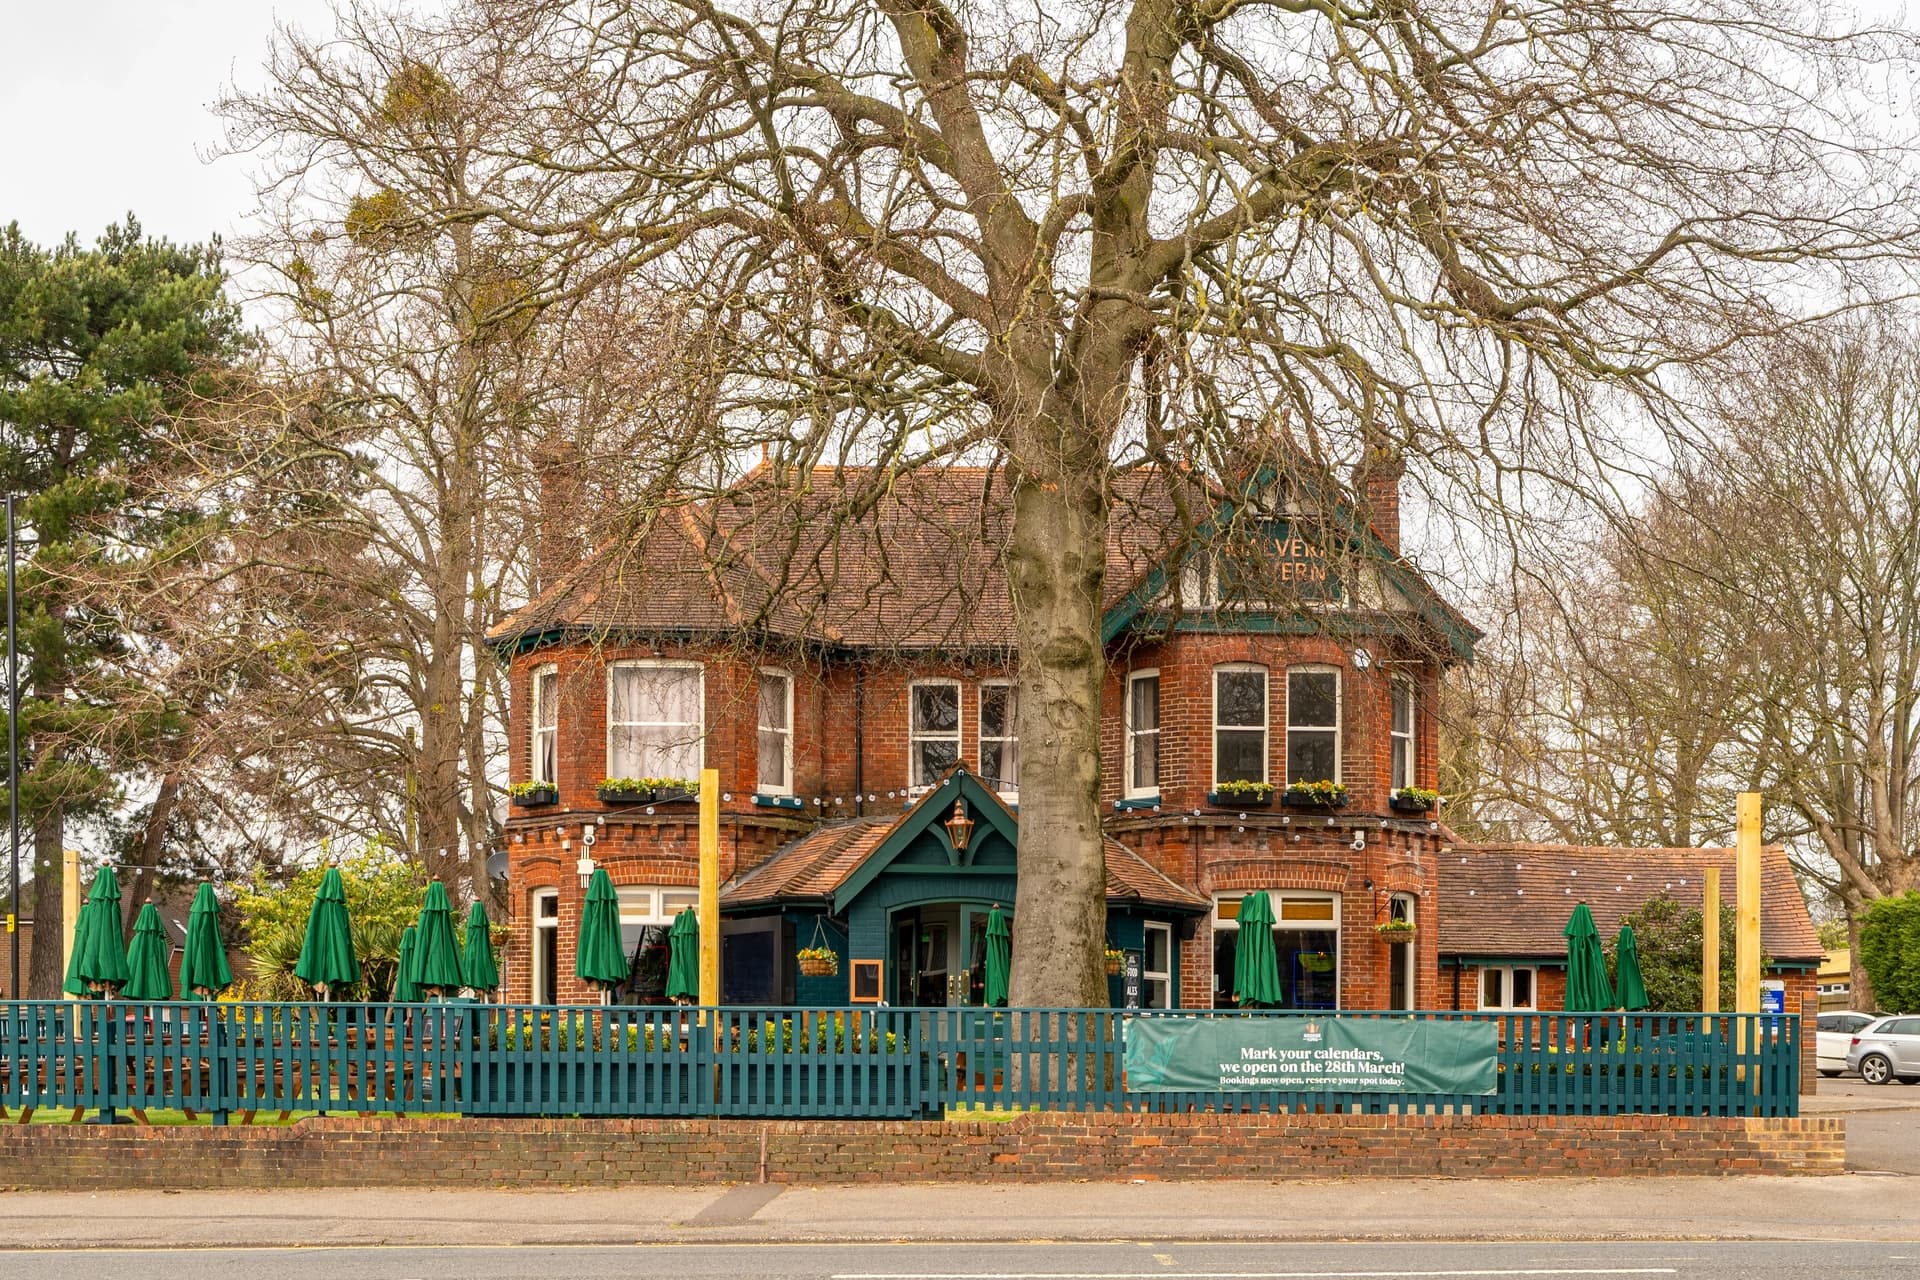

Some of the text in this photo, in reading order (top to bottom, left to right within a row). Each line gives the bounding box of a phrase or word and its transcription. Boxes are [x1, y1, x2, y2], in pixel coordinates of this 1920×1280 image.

[1126, 985, 1138, 996] ALES
[1241, 1047, 1384, 1062] Mark your calendars,
[1219, 1060, 1405, 1076] we open on the 28th March!
[1219, 1075, 1259, 1085] Bookings
[1305, 1077, 1338, 1085] reserve
[1338, 1078, 1359, 1086] your
[1360, 1077, 1378, 1086] spot
[1379, 1076, 1405, 1087] today.
